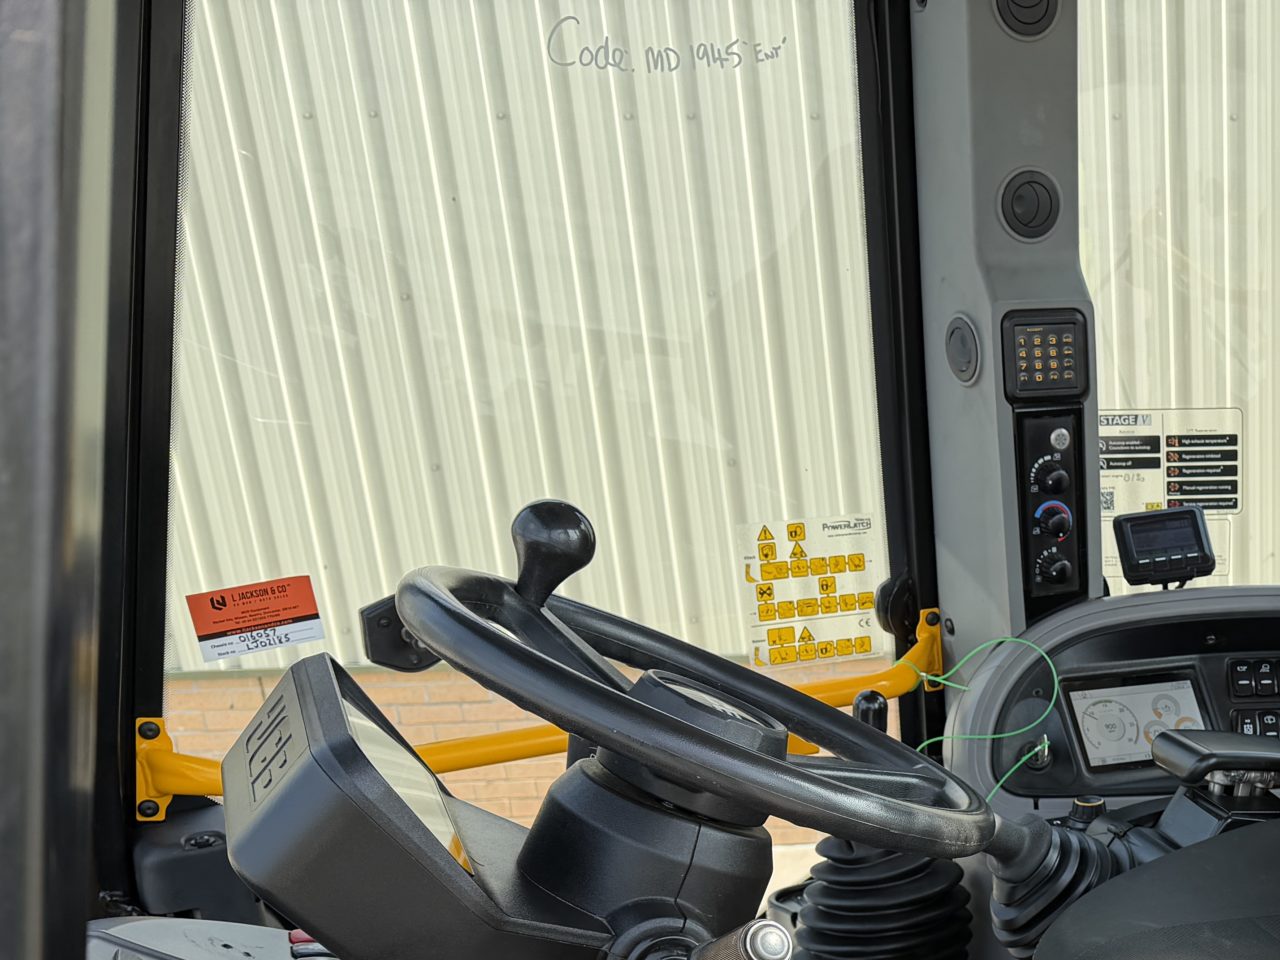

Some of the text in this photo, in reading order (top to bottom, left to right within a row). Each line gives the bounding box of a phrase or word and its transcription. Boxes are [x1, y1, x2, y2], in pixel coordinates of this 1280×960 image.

[645, 46, 680, 73] MD
[689, 38, 743, 71] 1945
[1034, 337, 1041, 345] 2
[1049, 337, 1057, 345] 3
[1100, 415, 1136, 426] STAGE
[231, 594, 237, 602] L
[238, 587, 269, 602] JACKSON
[276, 584, 287, 594] CO
